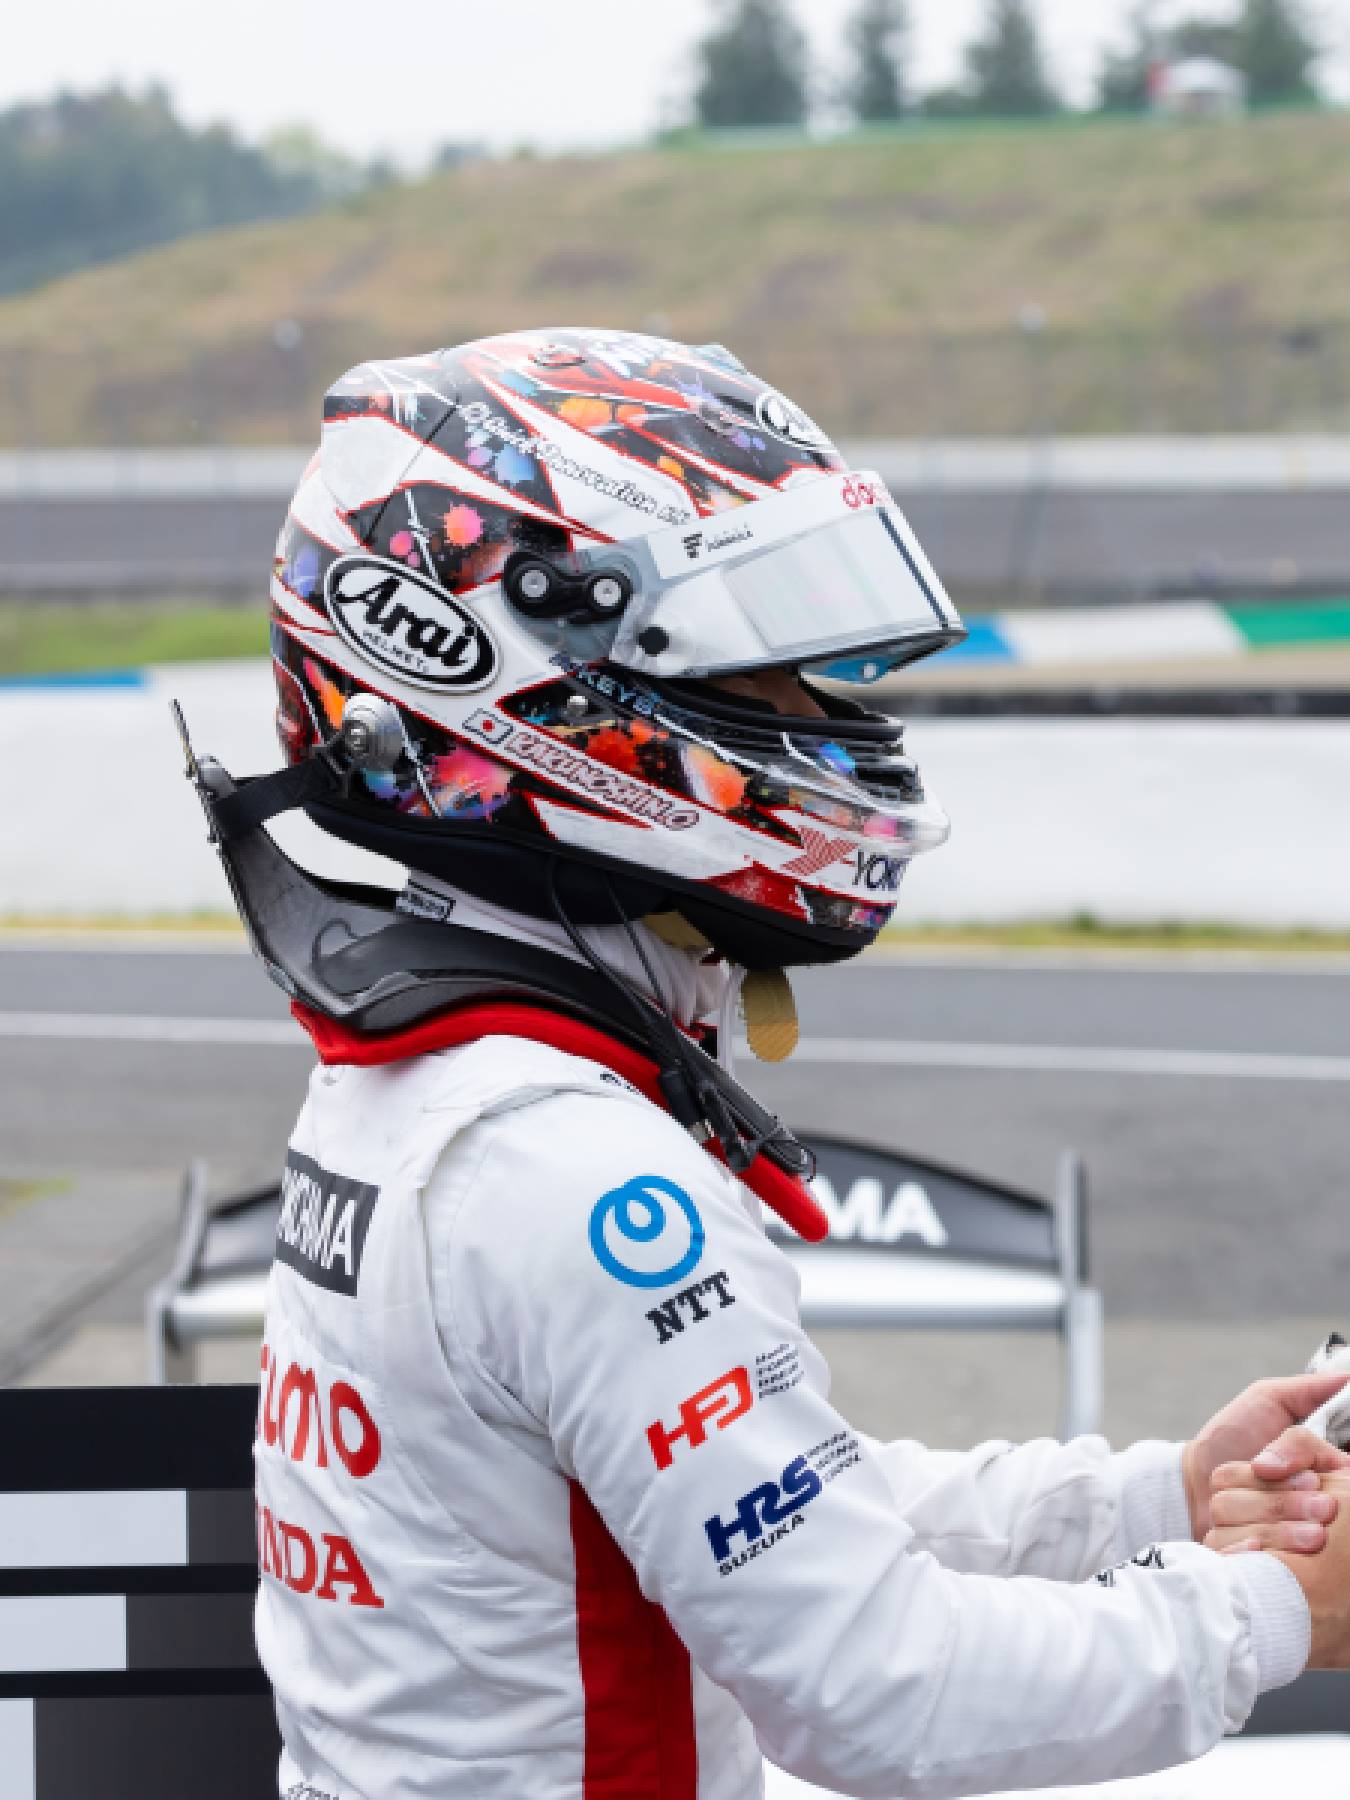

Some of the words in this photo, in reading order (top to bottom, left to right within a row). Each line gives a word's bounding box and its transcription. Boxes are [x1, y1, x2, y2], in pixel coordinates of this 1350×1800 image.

[334, 573, 478, 669] Arai
[645, 1270, 736, 1344] NTT
[705, 1455, 823, 1561] HRS
[719, 1513, 805, 1578] SUZUKA
[258, 1505, 385, 1609] NDA
